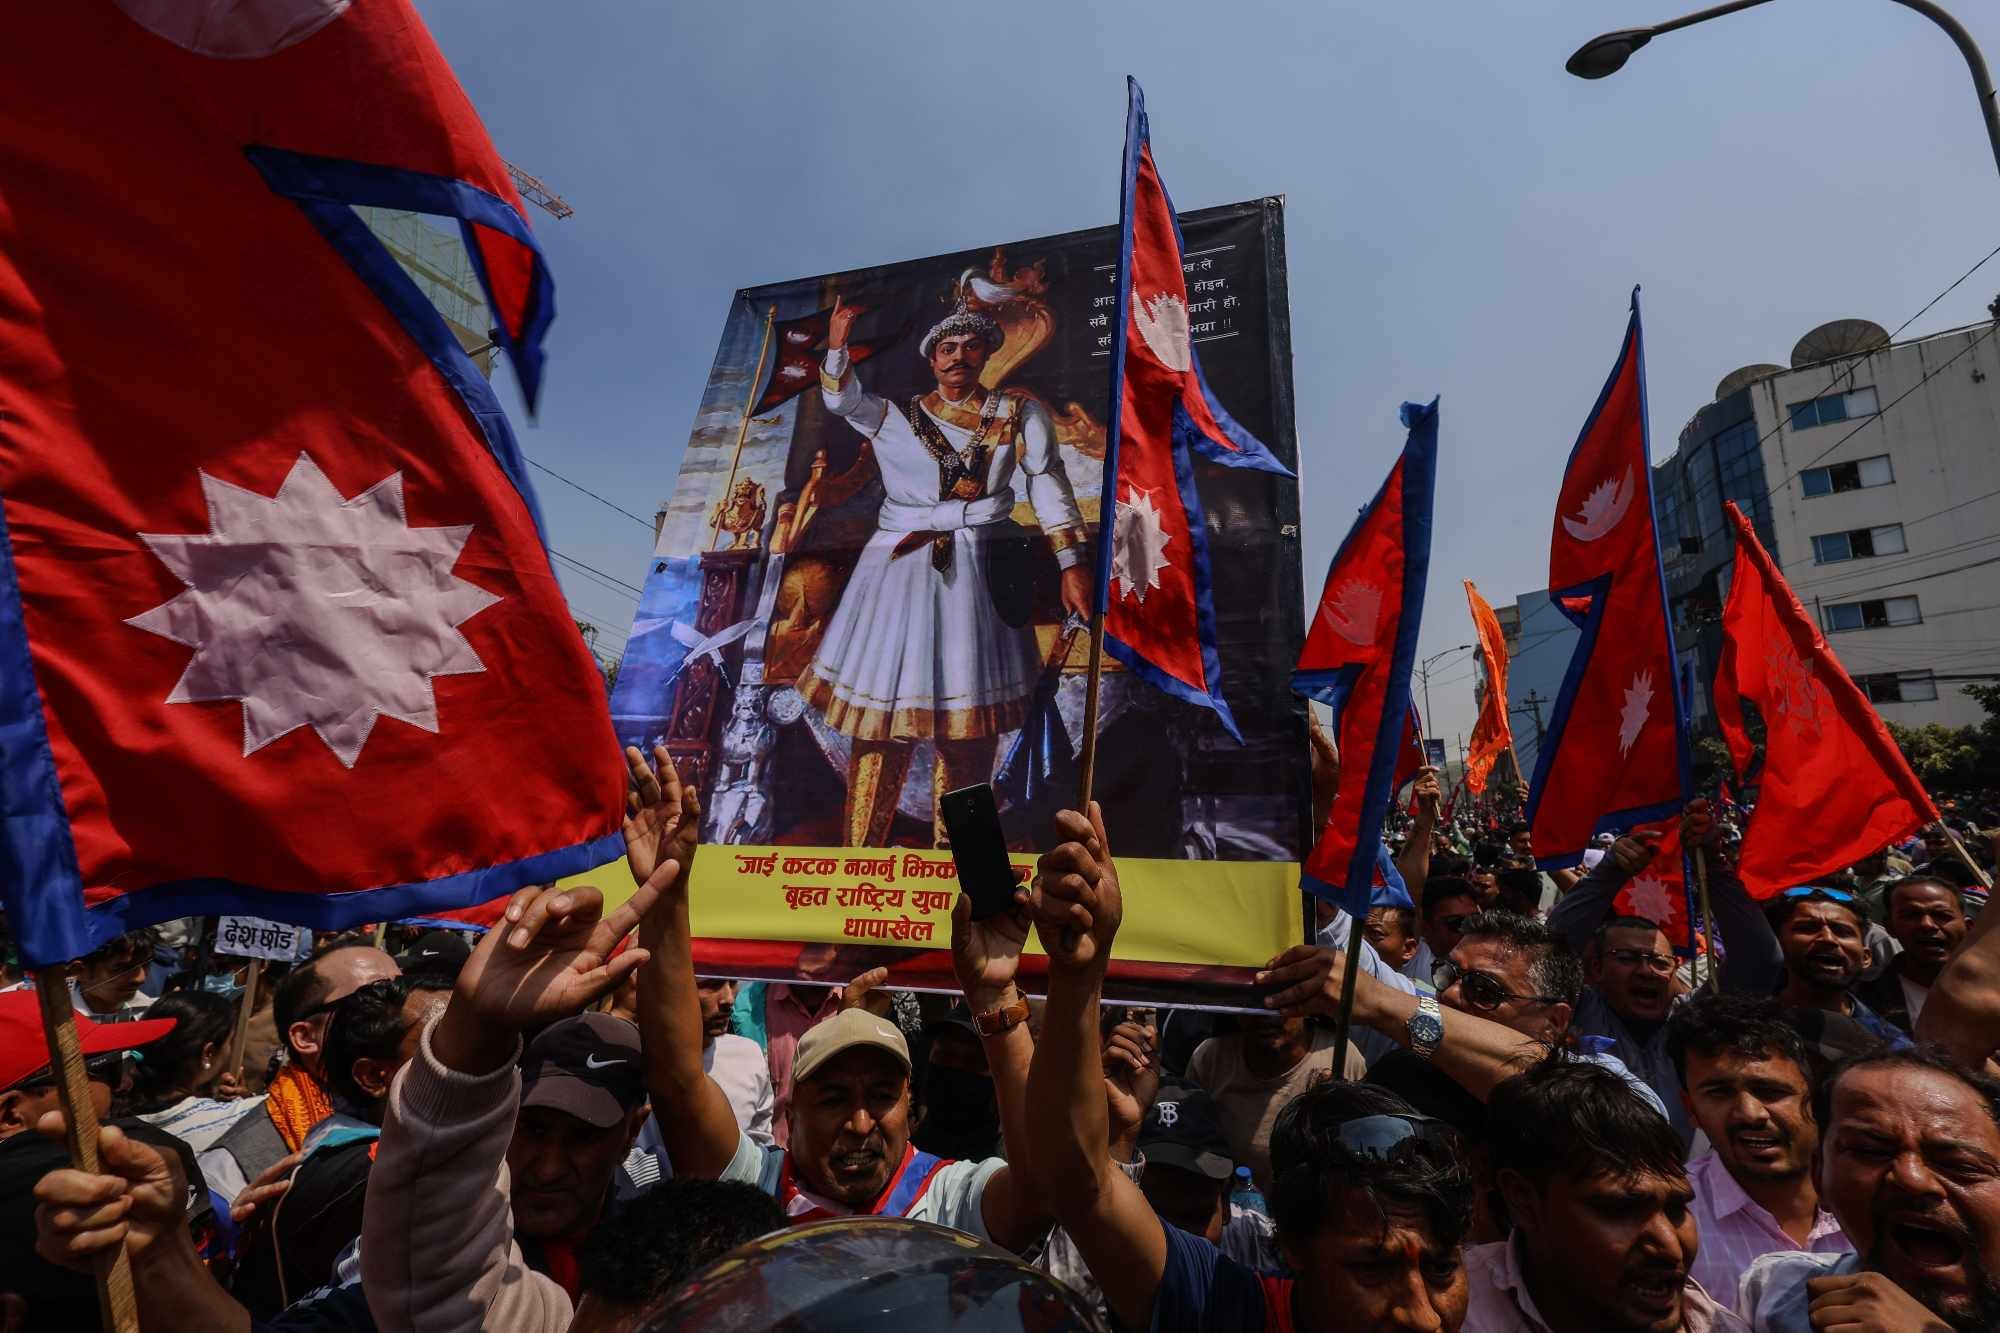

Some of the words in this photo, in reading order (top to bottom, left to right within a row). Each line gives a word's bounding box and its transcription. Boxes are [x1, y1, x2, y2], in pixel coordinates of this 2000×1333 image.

[1187, 298, 1217, 313] बारी
[782, 857, 839, 876] कटक
[844, 854, 897, 882] नगर्नु
[836, 882, 906, 912] राष्ट्रिय
[912, 890, 953, 914] युवा
[225, 918, 258, 949] देश
[260, 923, 295, 950] छोड
[844, 914, 935, 940] धापाखेल
